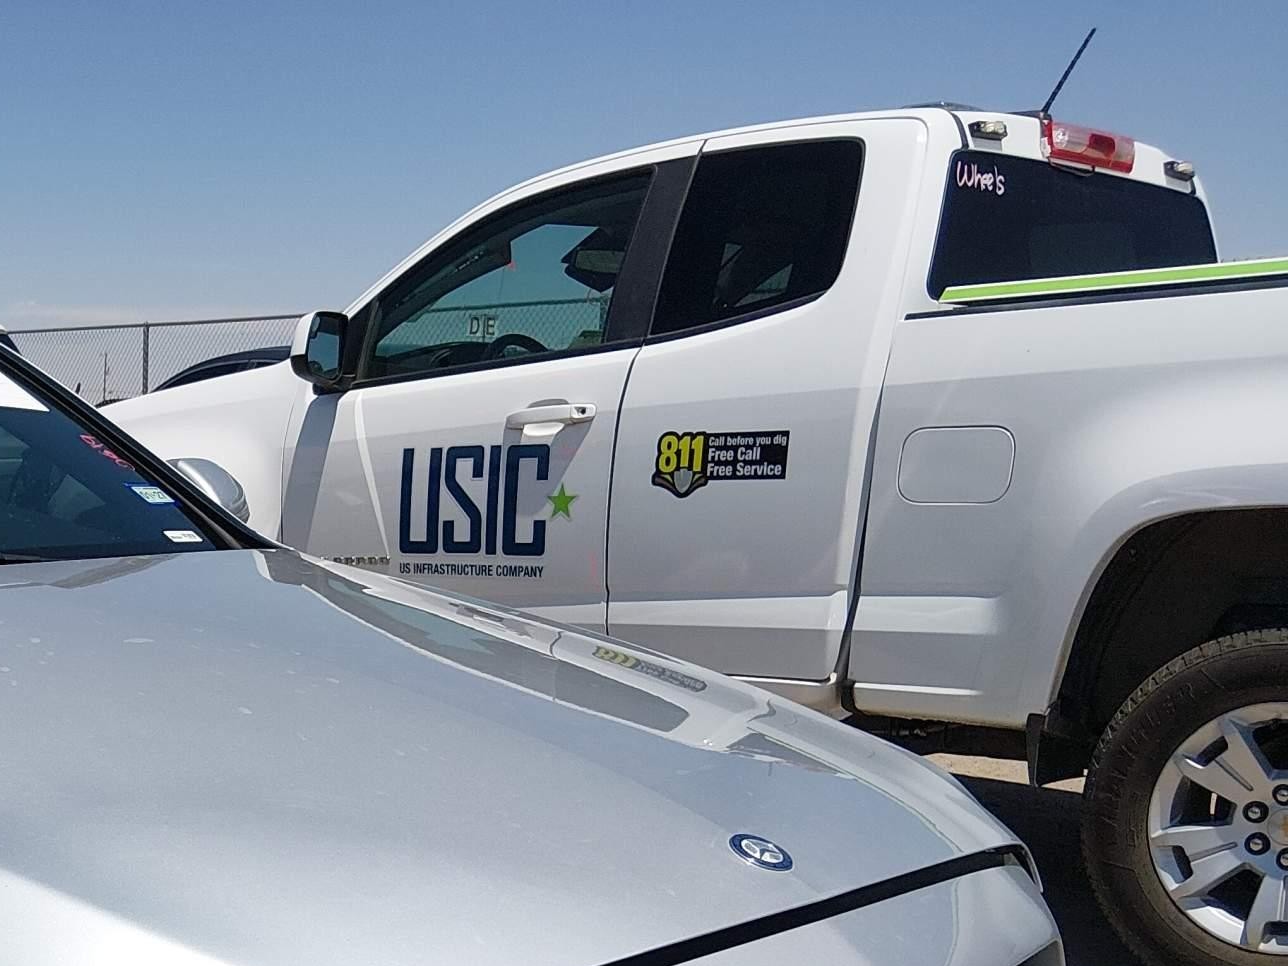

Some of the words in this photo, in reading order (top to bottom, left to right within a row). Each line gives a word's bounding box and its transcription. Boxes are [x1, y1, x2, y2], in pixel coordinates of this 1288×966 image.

[708, 436, 725, 446] Call
[726, 435, 754, 446] before
[755, 436, 771, 446] you
[773, 434, 788, 446] dig
[658, 434, 705, 473] 811
[707, 448, 734, 461] Free
[737, 447, 761, 461] Call
[706, 463, 733, 476] Free
[736, 462, 782, 476] Service
[399, 443, 551, 556] USIC
[399, 562, 411, 575] US
[413, 562, 493, 577] INFRASTRUCTURE
[496, 564, 544, 578] COMPANY
